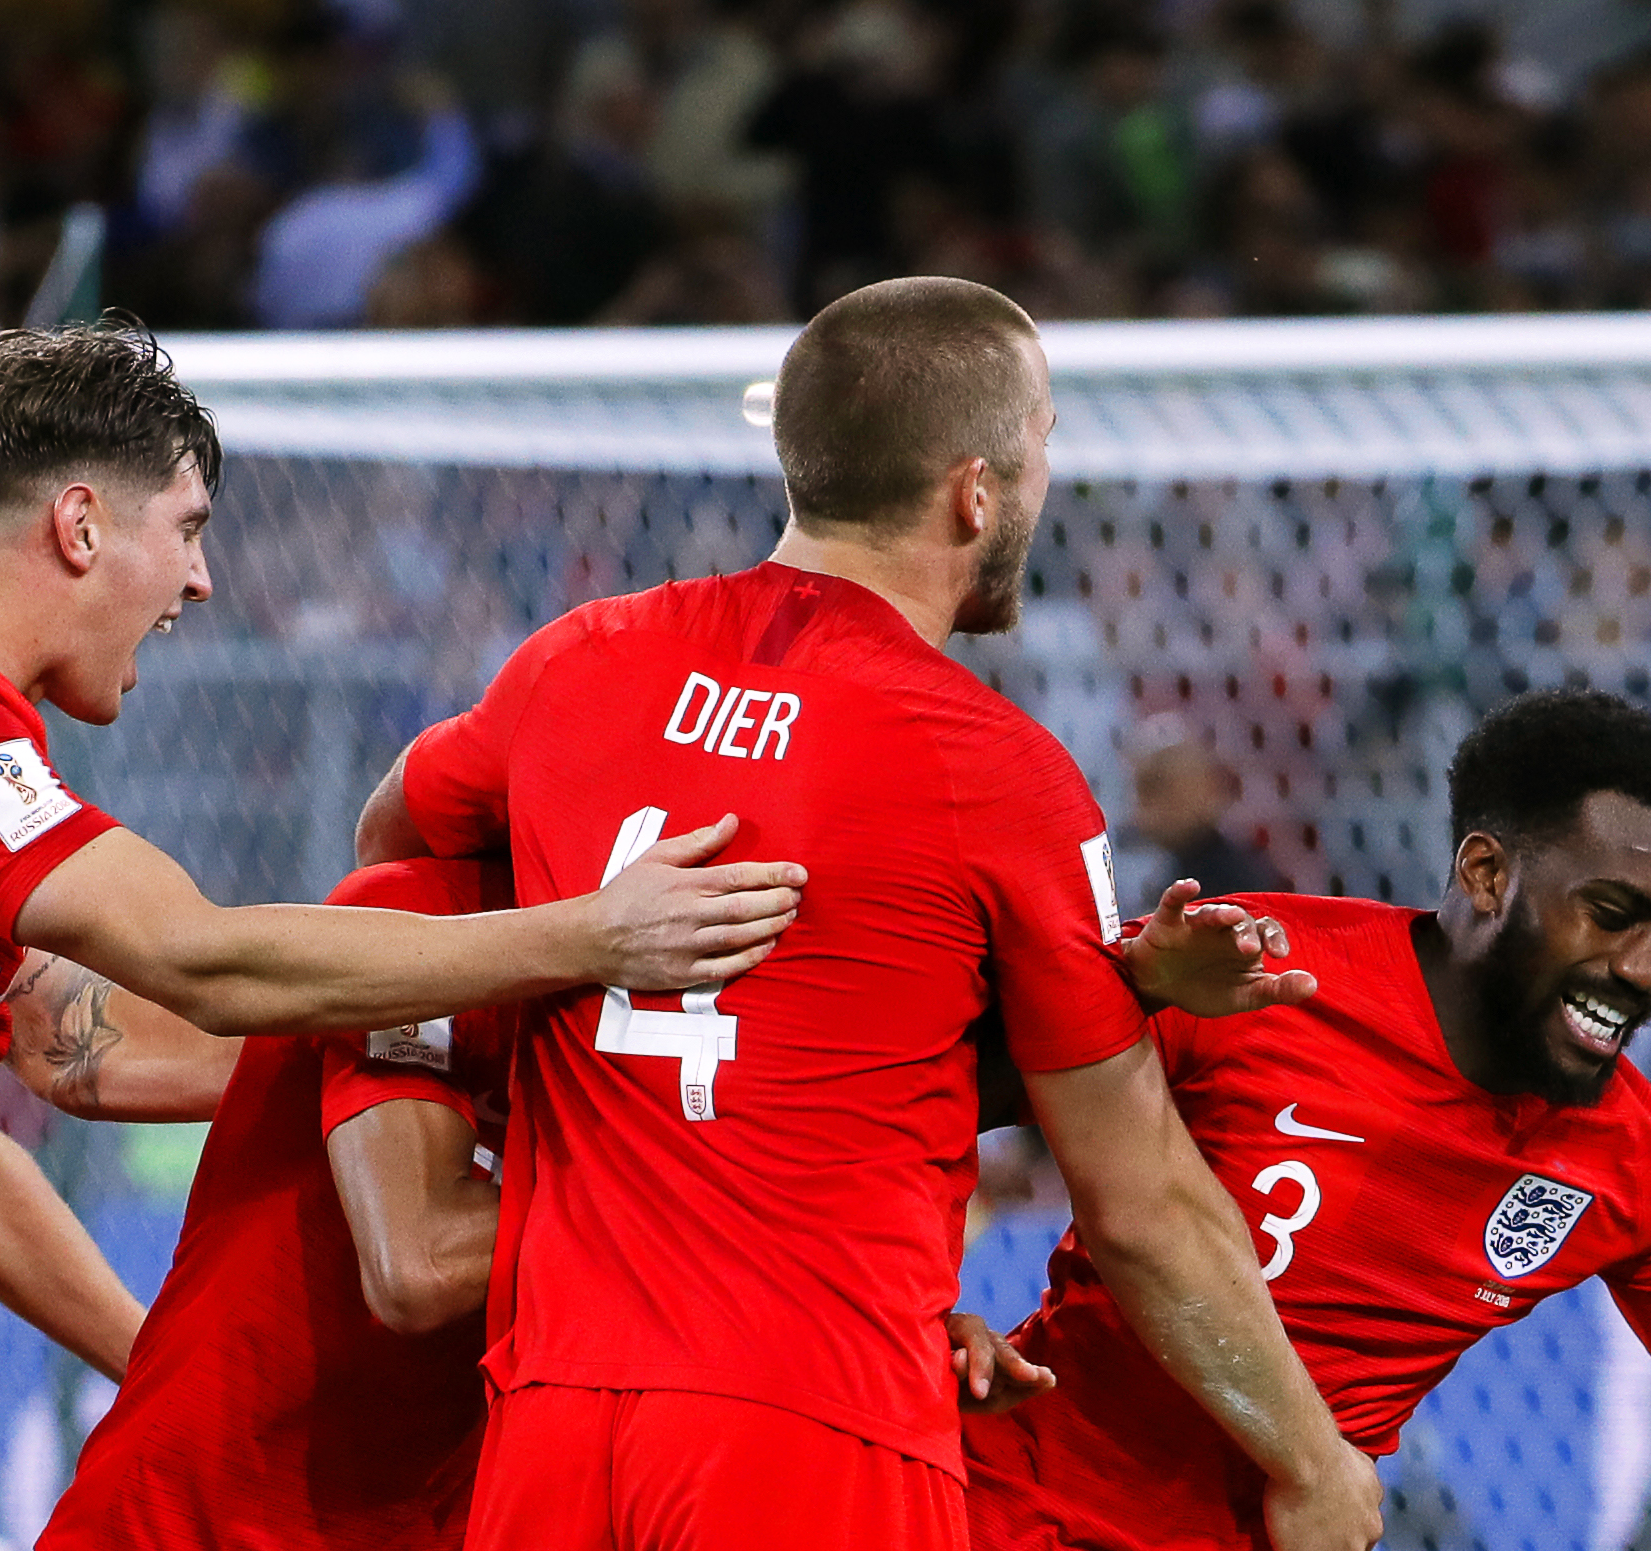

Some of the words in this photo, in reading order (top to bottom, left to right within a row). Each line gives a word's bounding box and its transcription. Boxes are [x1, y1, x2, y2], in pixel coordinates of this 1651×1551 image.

[663, 671, 802, 761] DIER
[10, 811, 53, 842] RUSSIA
[594, 805, 738, 1122] 4
[1250, 1159, 1322, 1281] 3
